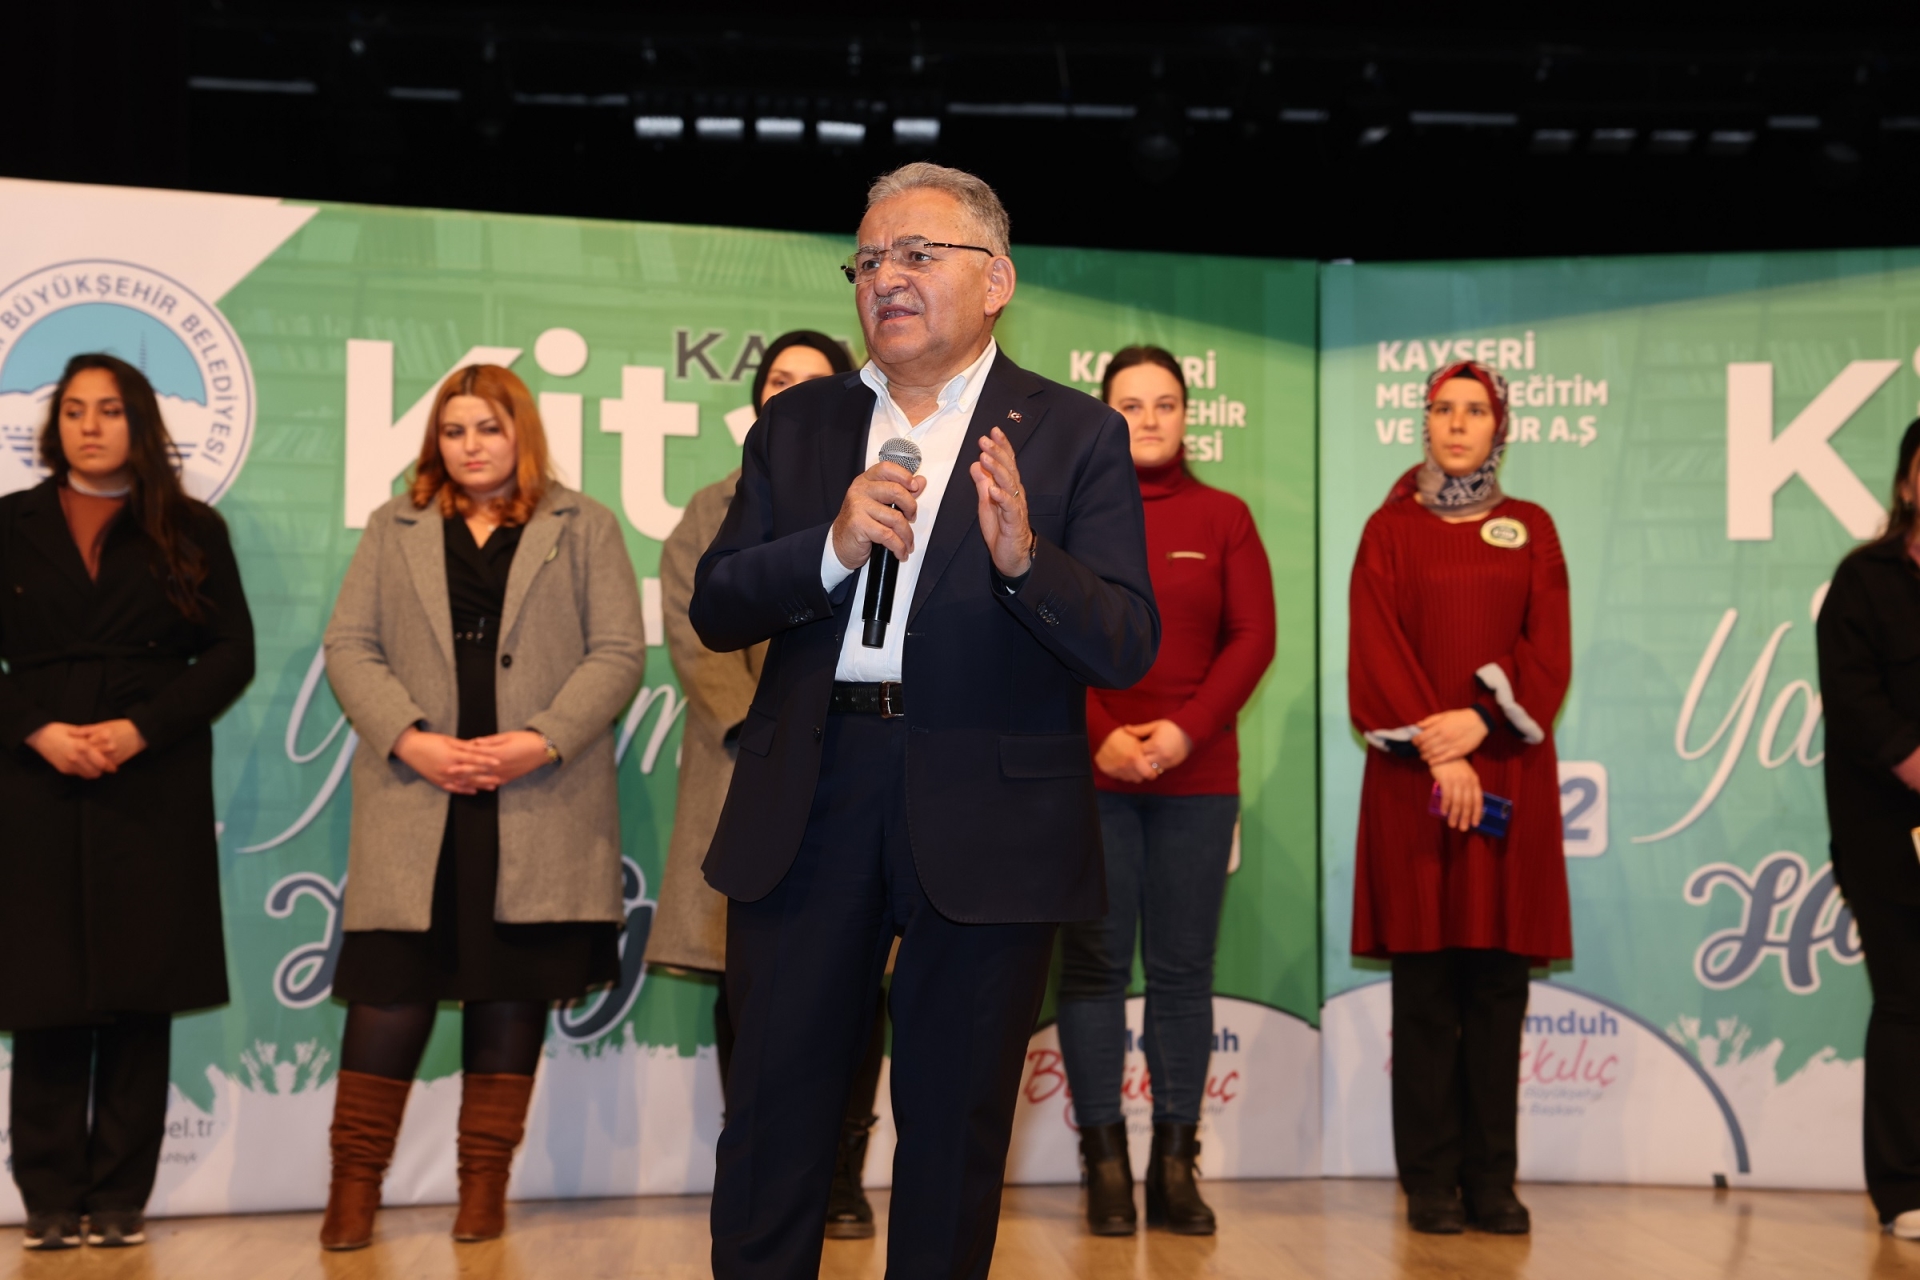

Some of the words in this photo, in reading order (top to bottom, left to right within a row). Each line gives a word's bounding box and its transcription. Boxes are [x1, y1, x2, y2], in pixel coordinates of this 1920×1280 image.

[1, 273, 178, 331] BÜYÜKŞEHİR
[180, 313, 240, 466] BELEDİYESİ
[1508, 373, 1608, 408] EĞİTİM
[344, 326, 757, 542] Kit
[1375, 418, 1415, 445] VE
[1548, 415, 1598, 448] A.Ş
[1630, 607, 1825, 844] Ya
[1524, 1008, 1619, 1036] mduh
